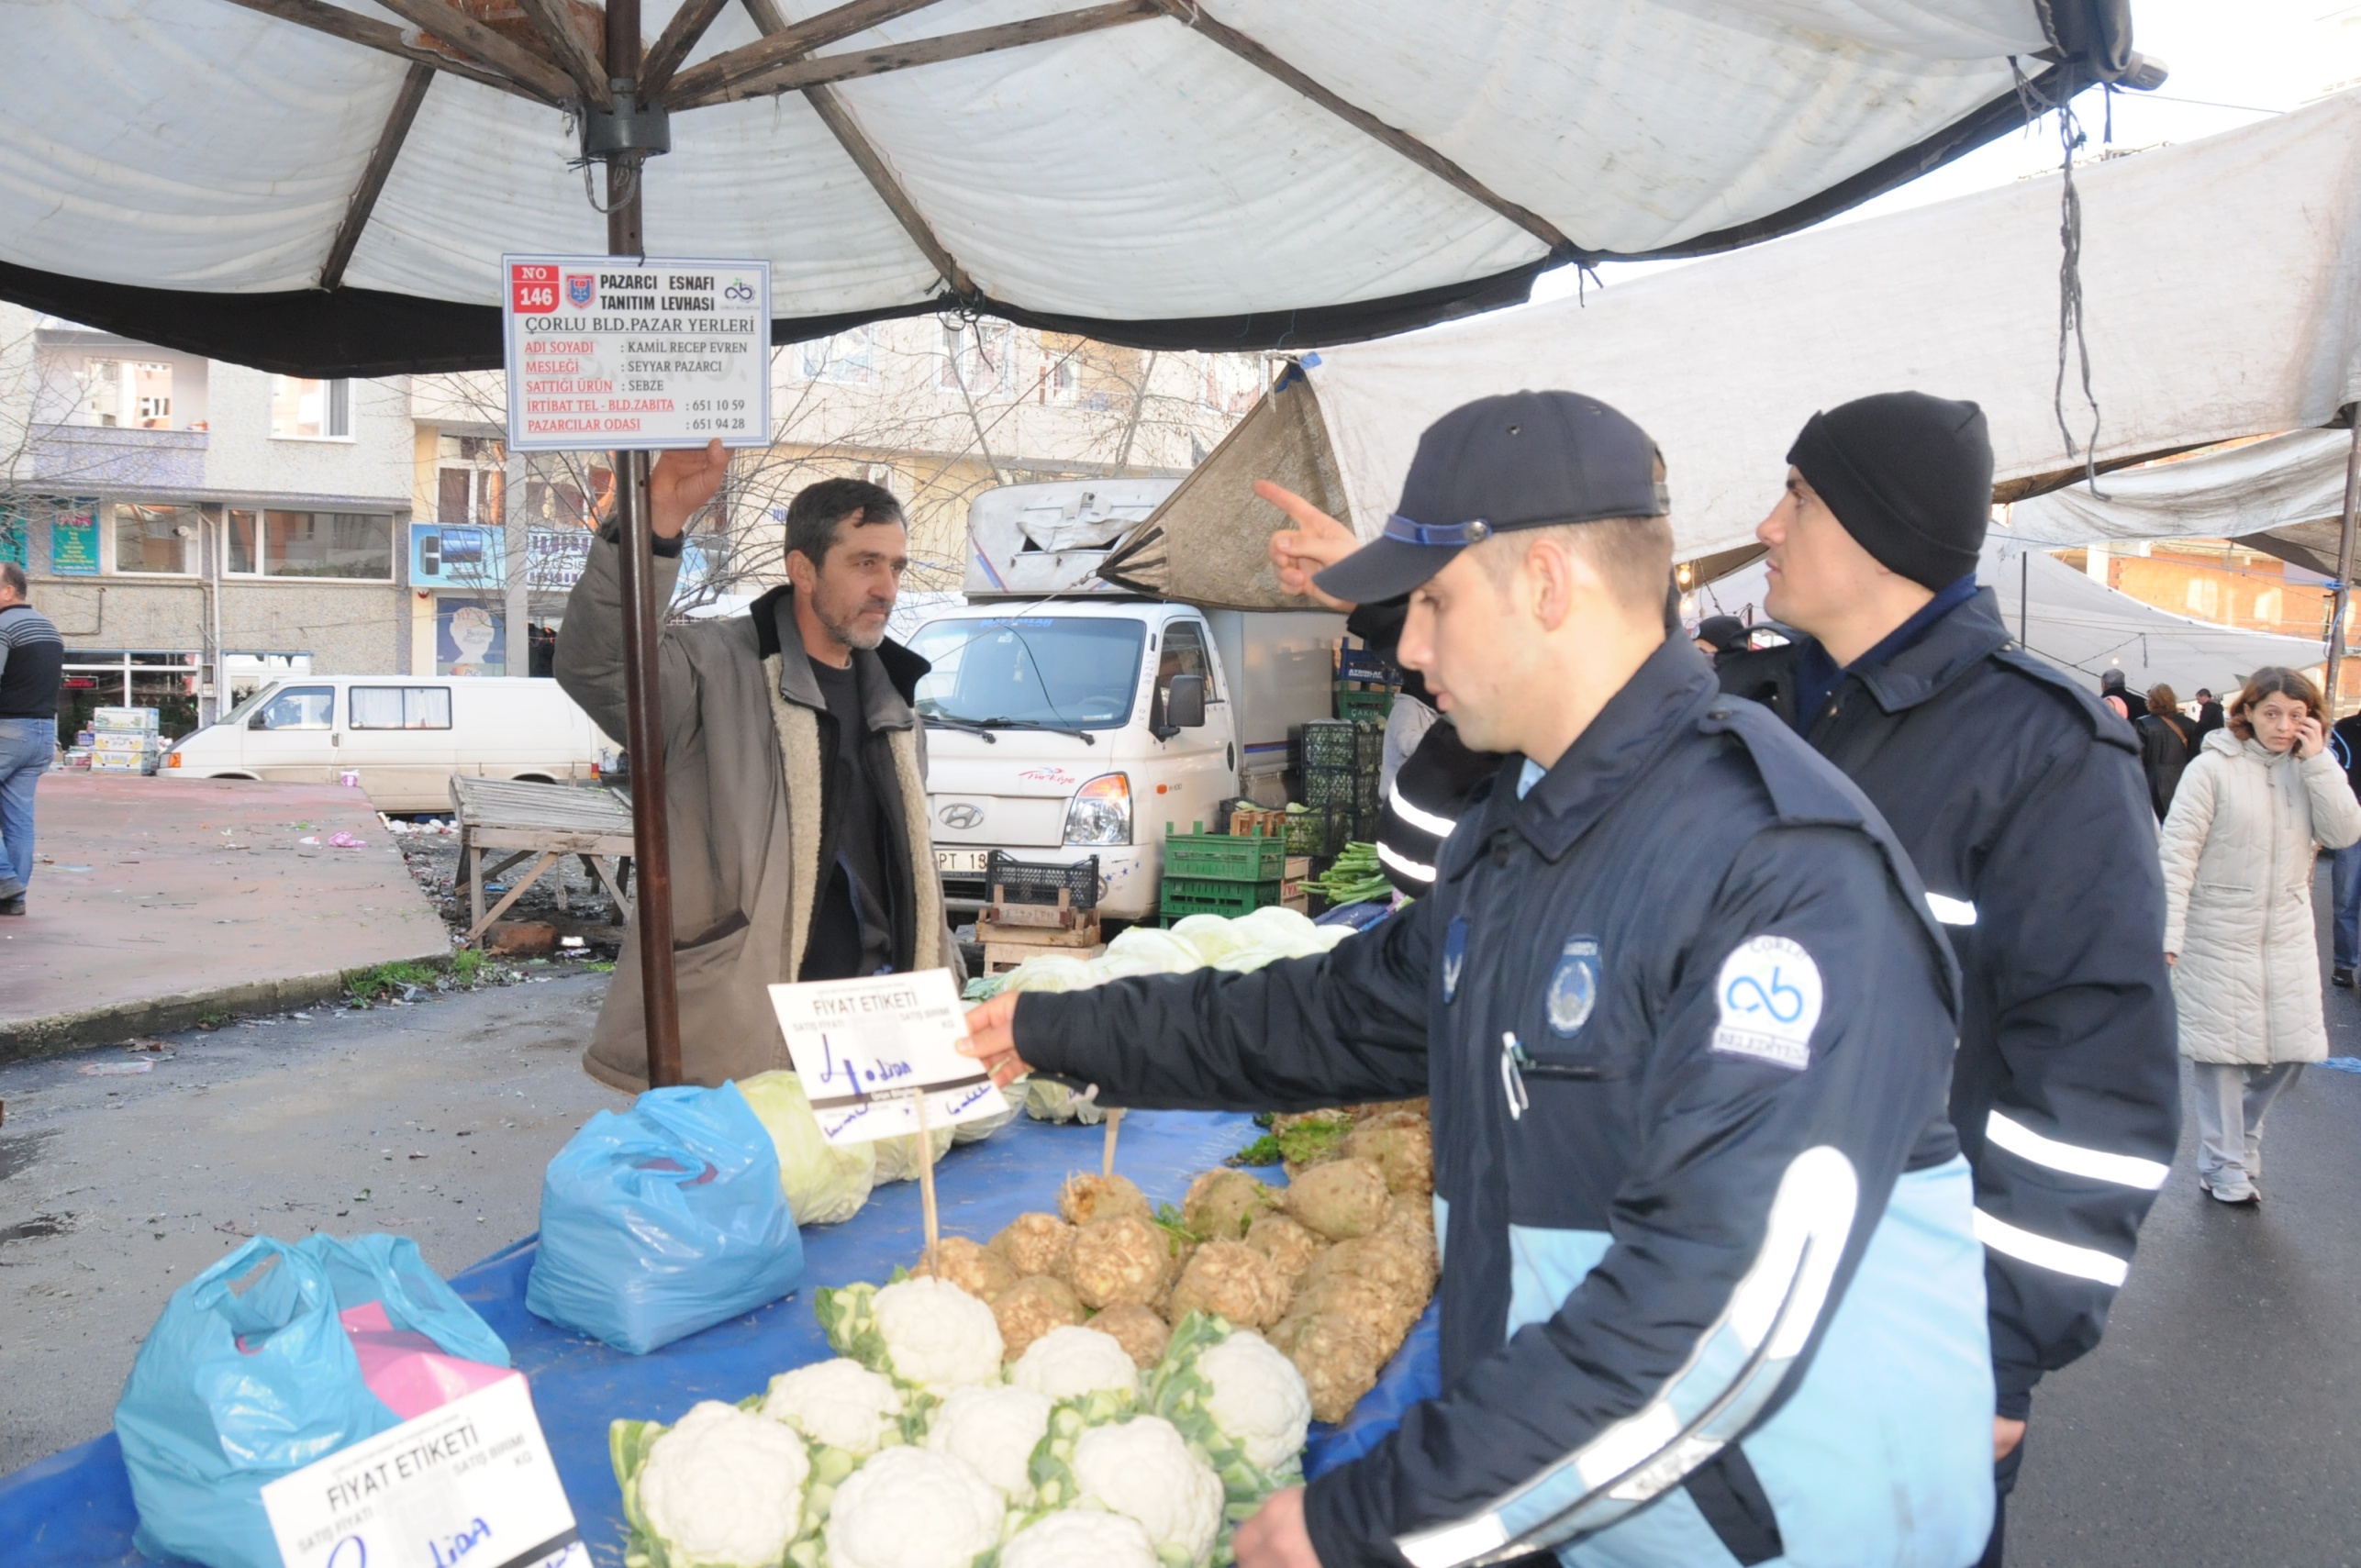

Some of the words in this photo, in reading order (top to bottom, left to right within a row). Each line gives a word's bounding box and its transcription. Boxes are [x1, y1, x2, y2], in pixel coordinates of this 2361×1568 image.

[521, 267, 548, 280] NO
[600, 274, 657, 290] PAZARCI
[669, 276, 715, 291] ESNAFI
[520, 287, 553, 306] 146
[600, 295, 655, 310] TANITIM
[661, 295, 715, 311] LEVHASI
[525, 317, 585, 334] ÇORLU
[593, 317, 683, 332] BLD.PAZAR
[687, 316, 755, 332] YERLERİ
[525, 341, 547, 354] ADI
[550, 341, 595, 354] SOYADI
[628, 339, 667, 353] KAMİL
[670, 342, 707, 353] RECEP
[709, 342, 748, 353] EVREN
[525, 358, 580, 373] MESLEĞİ
[628, 361, 672, 373] SEYYAR
[674, 361, 722, 373] PAZARCI
[527, 378, 574, 393] SATTIĞI
[577, 377, 613, 392] ÜRÜN
[629, 381, 664, 392] SEBZE
[527, 397, 573, 412] İRTİBAT
[576, 400, 599, 411] TEL
[608, 399, 675, 411] BLD.ZABITA
[692, 400, 712, 411] 651
[716, 400, 729, 411] 10
[732, 400, 745, 411] 59
[528, 420, 600, 431] PAZARCILAR
[604, 418, 640, 431] ODASI
[693, 419, 712, 429] 651
[716, 419, 729, 429] 94
[732, 419, 745, 429] 28
[939, 853, 957, 869] PT
[813, 991, 856, 1016] FİYAT
[861, 985, 918, 1012] ETİKETİ
[327, 1462, 391, 1514] FİYAT
[395, 1416, 481, 1480] ETİKETİ
